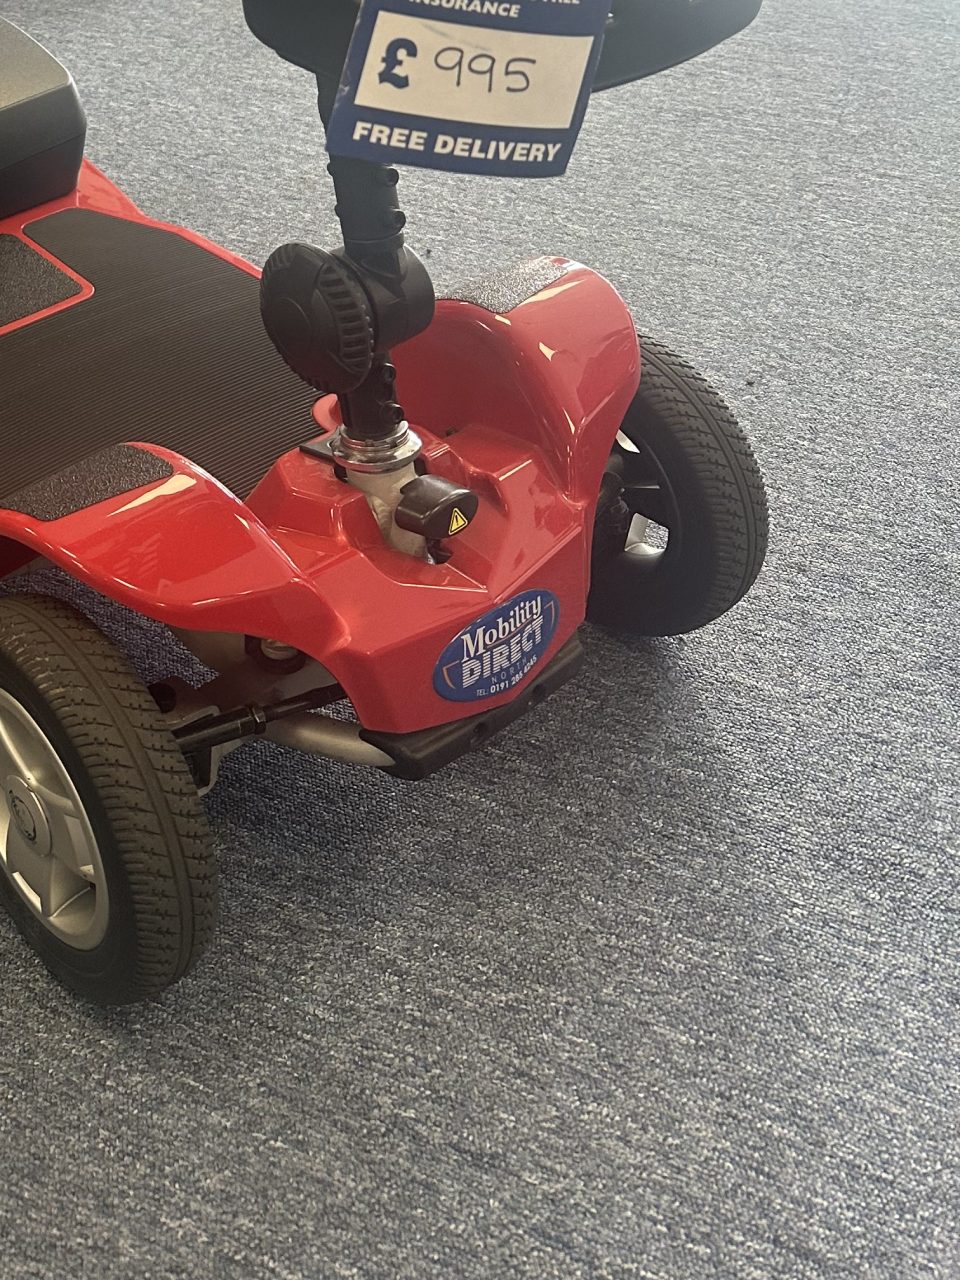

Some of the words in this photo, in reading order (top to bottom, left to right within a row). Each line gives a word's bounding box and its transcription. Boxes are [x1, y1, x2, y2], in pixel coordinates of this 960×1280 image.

[377, 38, 418, 89] £
[434, 46, 537, 93] 995
[352, 120, 428, 151] FREE
[433, 134, 562, 162] DELIVERY
[460, 595, 541, 662] Mobility
[462, 615, 544, 689] DIRECT
[490, 680, 509, 694] 0191
[491, 656, 528, 684] NORTH
